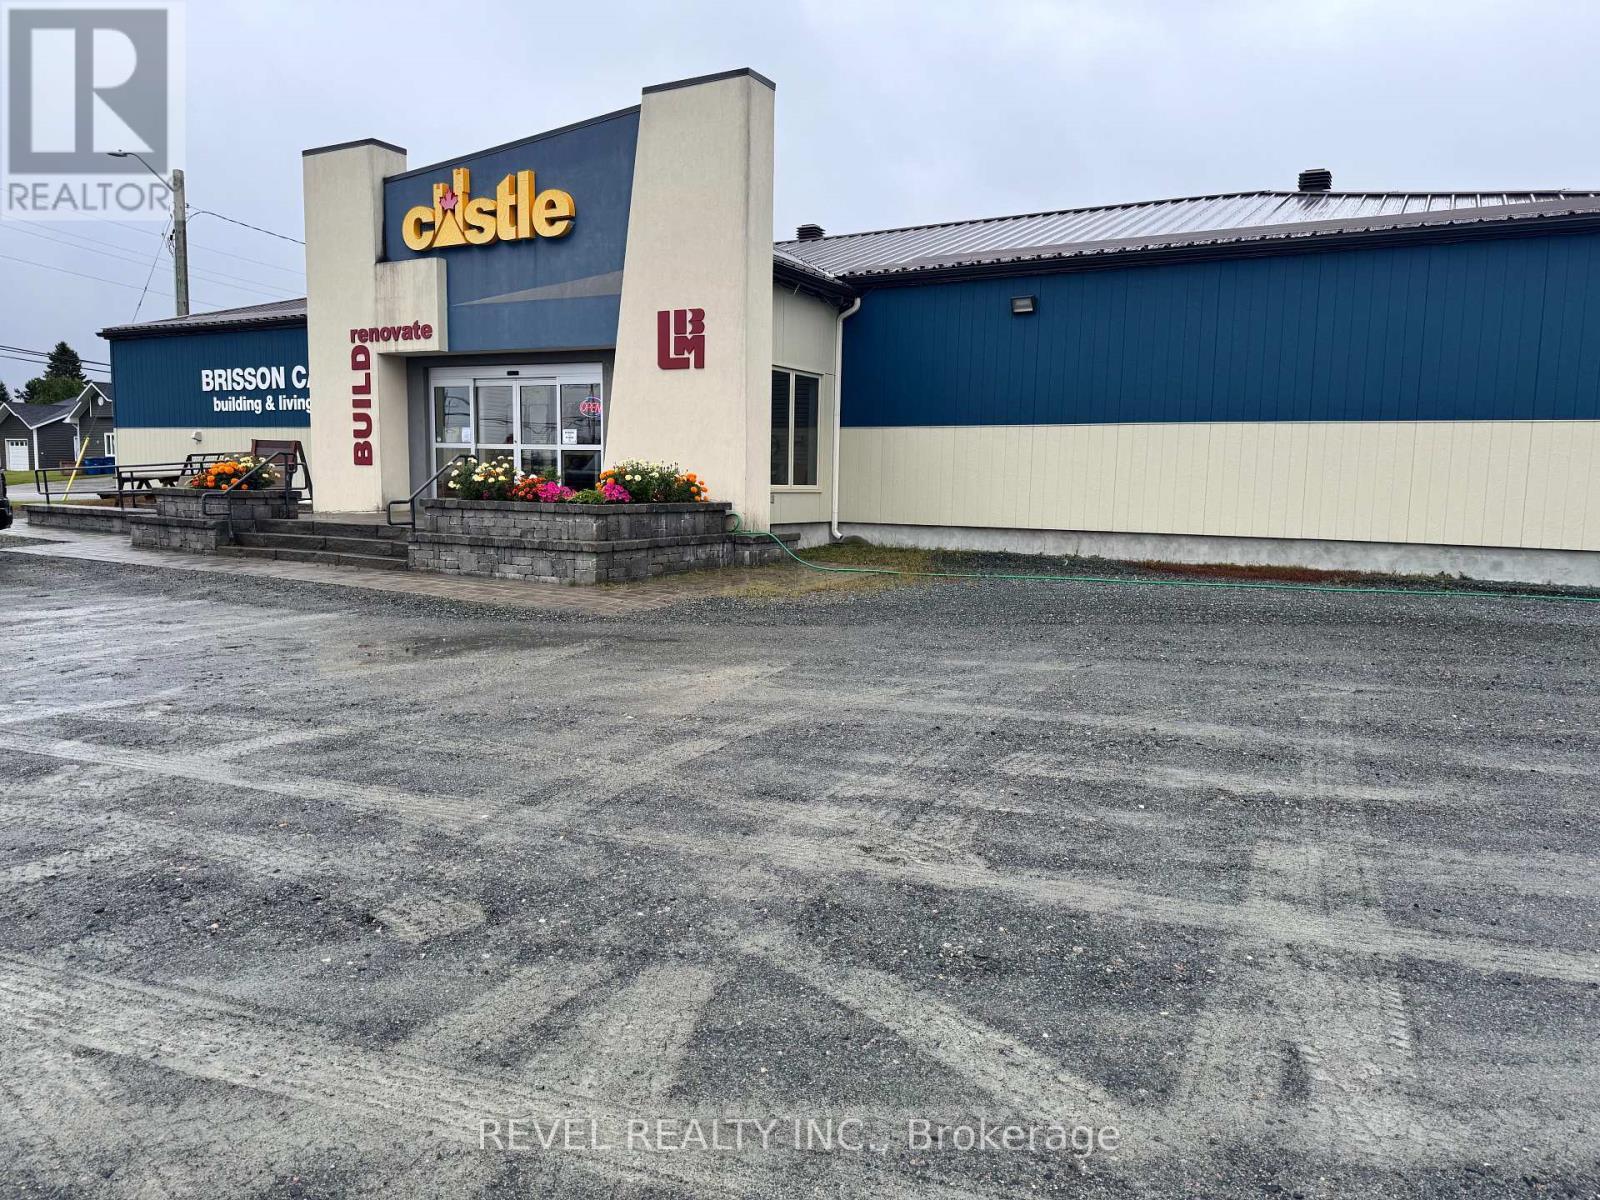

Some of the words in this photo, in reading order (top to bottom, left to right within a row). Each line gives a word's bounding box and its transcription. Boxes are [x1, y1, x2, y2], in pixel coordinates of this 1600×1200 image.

[402, 168, 576, 251] castle
[350, 320, 433, 343] renovate
[201, 366, 286, 392] BRISSON
[291, 365, 310, 389] C
[213, 396, 262, 414] building
[265, 395, 276, 411] &
[278, 394, 311, 414] living
[351, 345, 374, 466] BUILD
